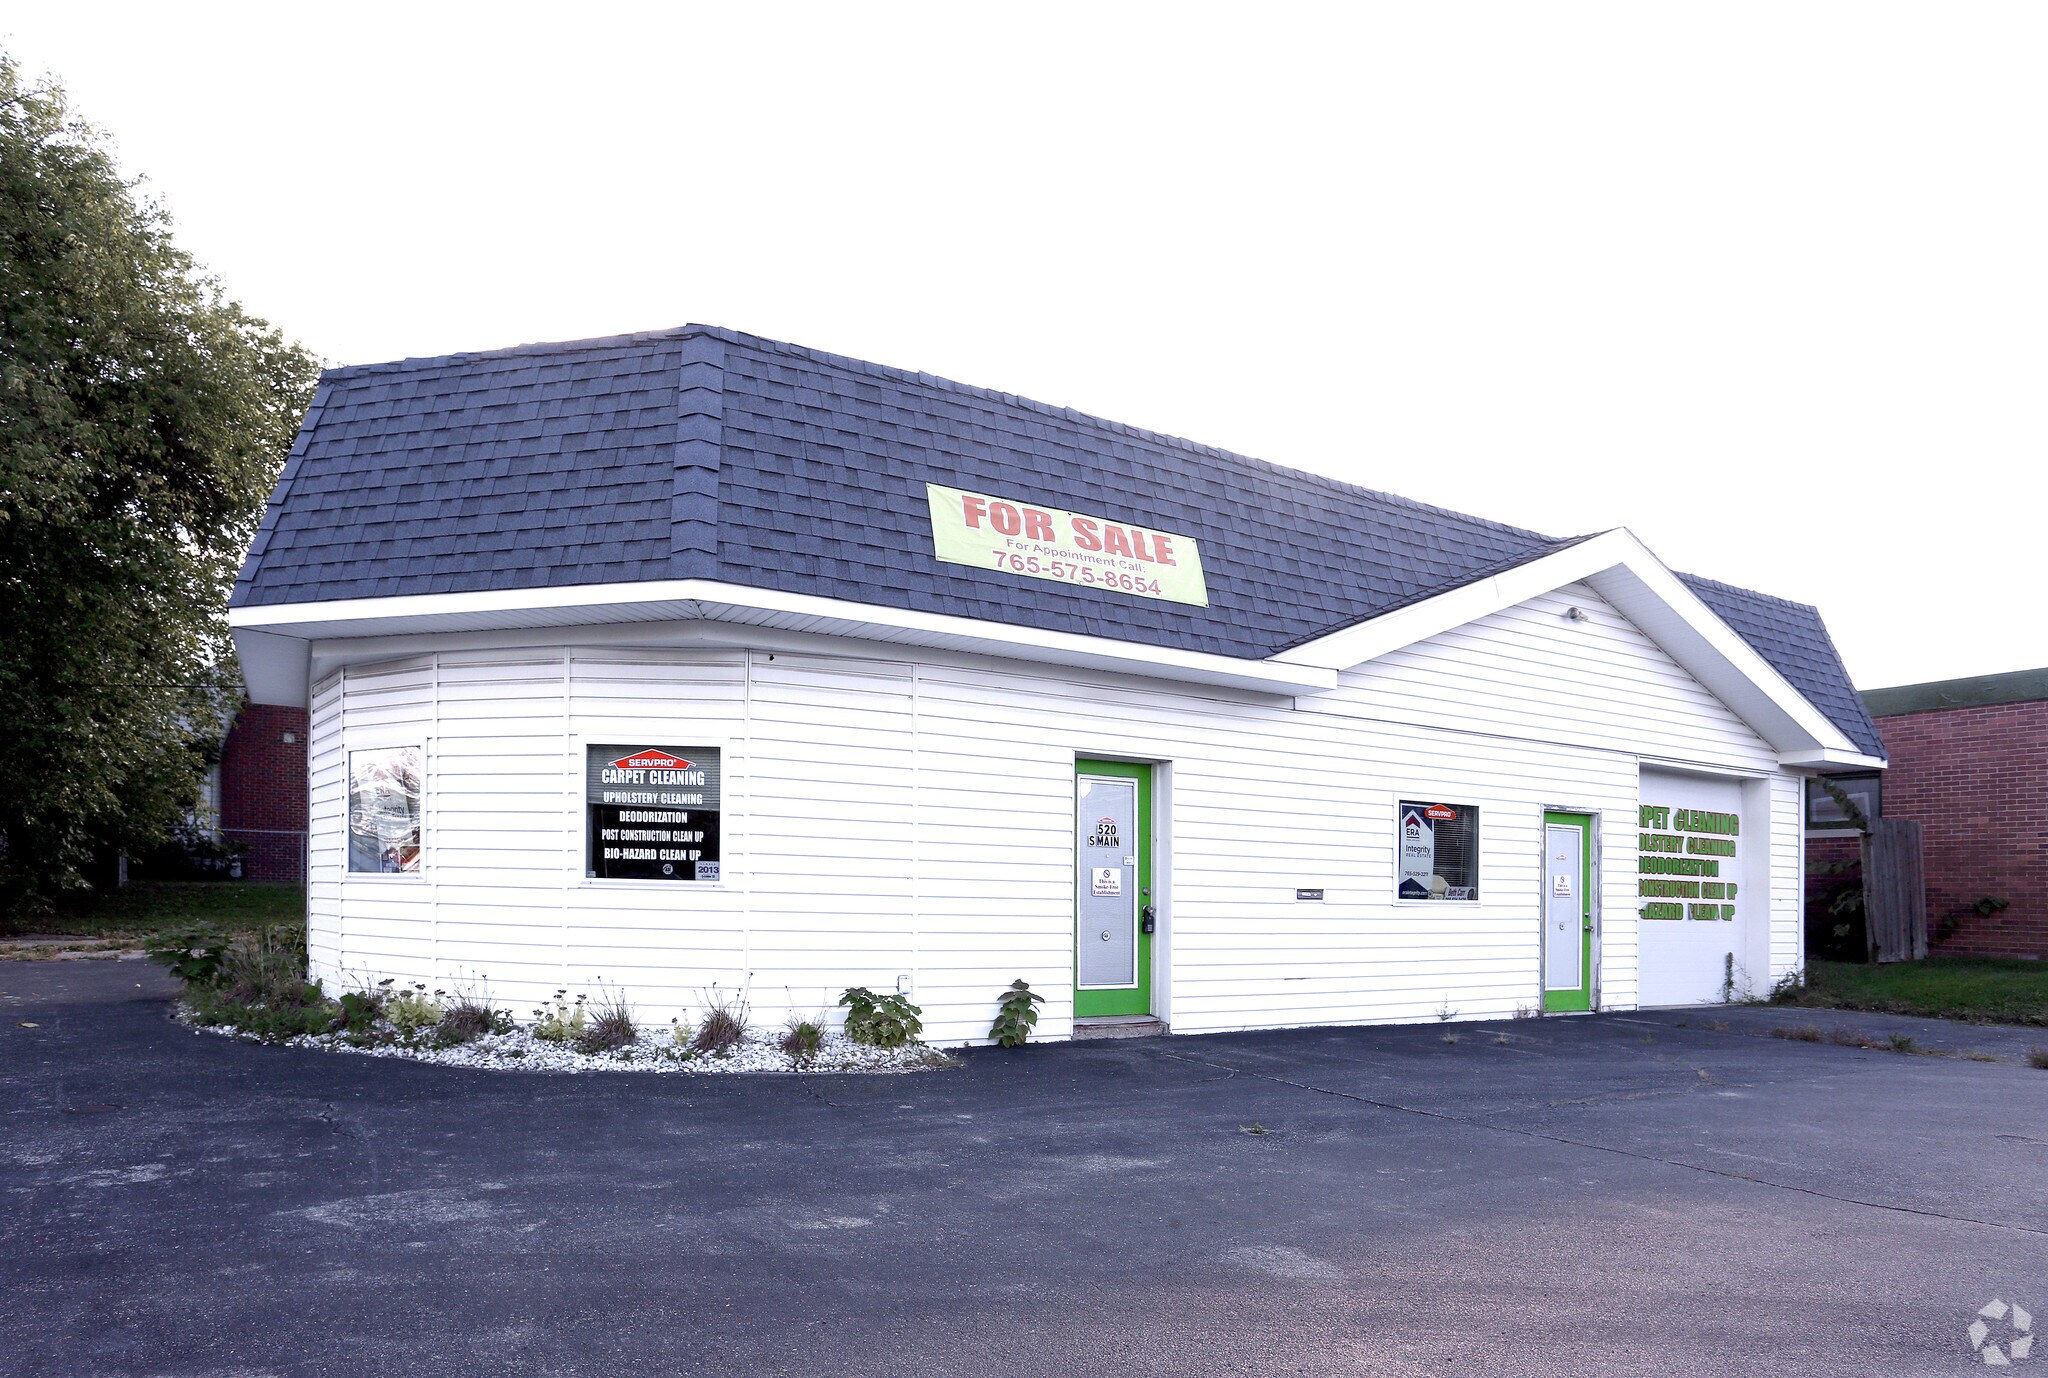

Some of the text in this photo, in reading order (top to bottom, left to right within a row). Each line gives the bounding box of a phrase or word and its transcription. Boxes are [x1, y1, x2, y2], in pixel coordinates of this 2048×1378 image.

[961, 494, 1177, 566] FOR SALE
[1006, 538, 1146, 573] For Appointment Call:
[992, 550, 1161, 595] 765-575-8654
[601, 769, 705, 786] CARPET CLEANING
[603, 791, 703, 805] UPHOLSTERY CLEANING
[619, 810, 688, 823] DEODORIZATION
[1428, 810, 1451, 818] SERVPRO
[1673, 808, 1739, 836] CLEANING
[601, 829, 704, 842] POST CONSTRUCTION CLEAN UP
[1098, 824, 1117, 835] 520
[1406, 828, 1420, 836] ERA
[1089, 835, 1120, 847] S MAIN
[1686, 836, 1736, 857] CLEANING
[604, 848, 702, 861] BIO-HAZARD CLEAN UP
[1406, 844, 1431, 854] Integrity
[697, 866, 719, 874] 2013
[1701, 881, 1725, 899] CLEAN
[1726, 882, 1738, 900] UP
[1721, 904, 1735, 921] UP
